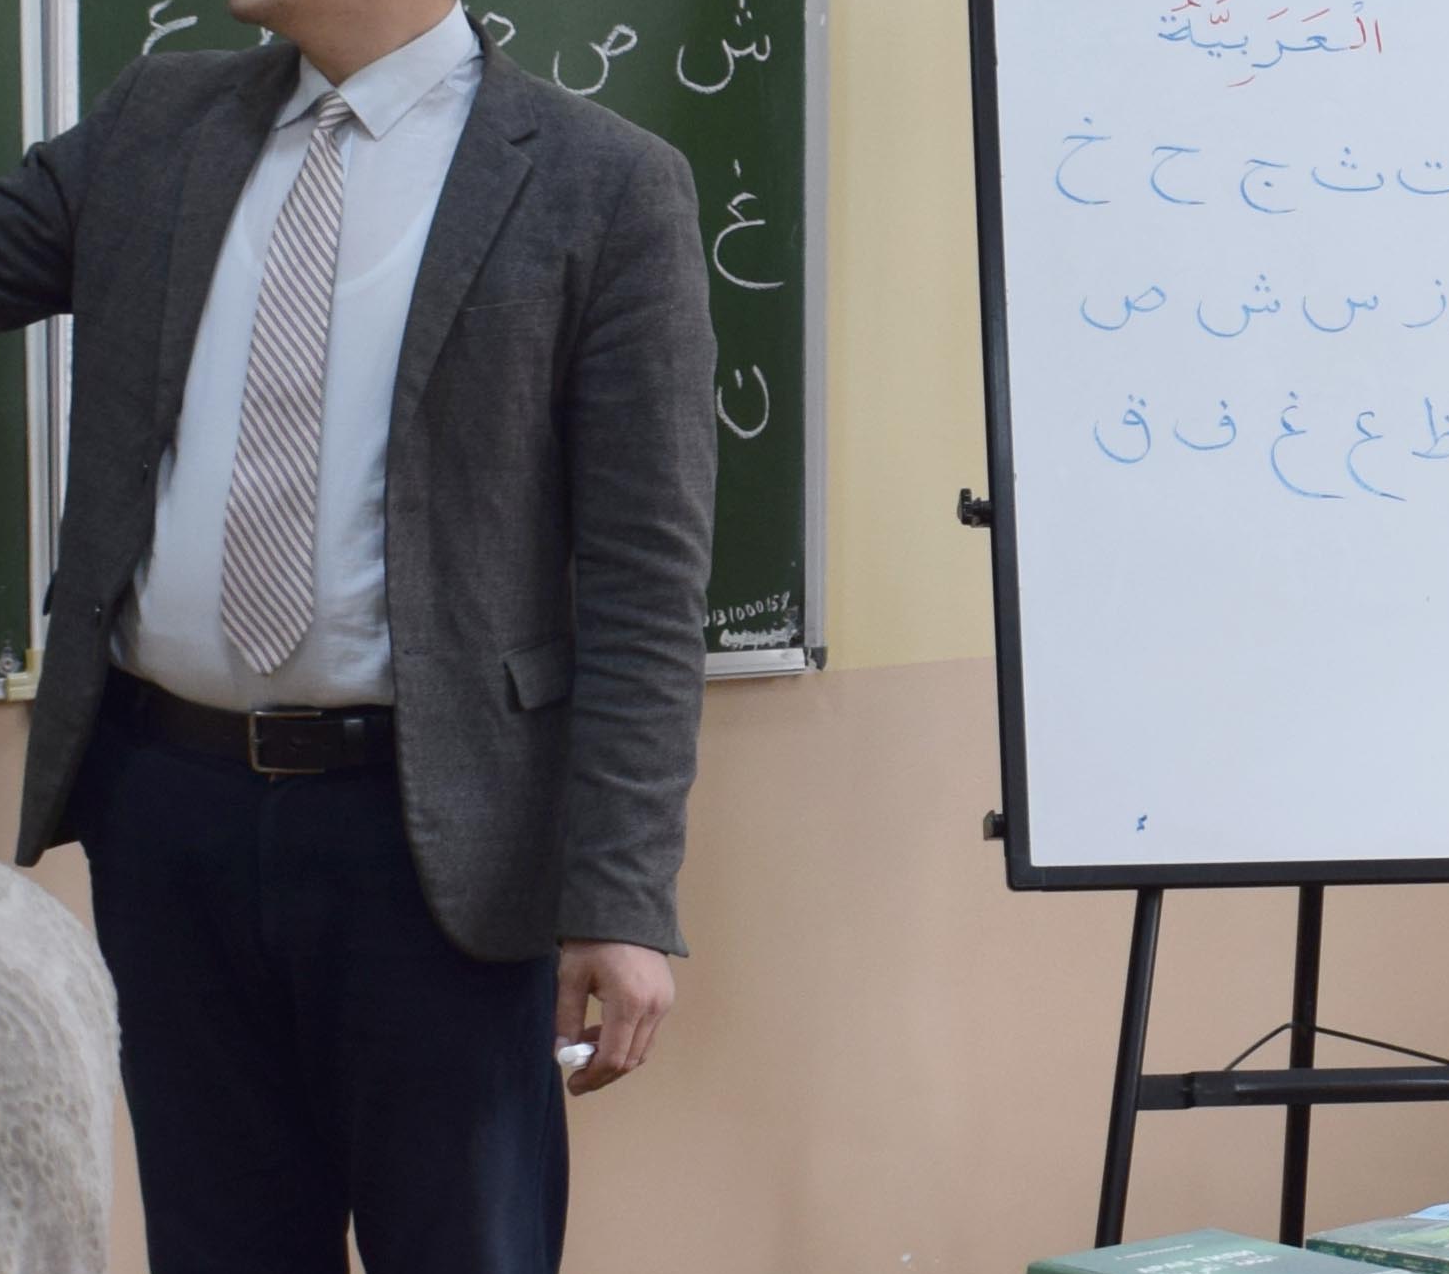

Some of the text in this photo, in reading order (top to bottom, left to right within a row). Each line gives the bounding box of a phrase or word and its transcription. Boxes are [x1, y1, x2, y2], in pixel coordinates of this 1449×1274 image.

[553, 24, 639, 96] ص
[1055, 116, 1113, 205] خ
[1150, 145, 1206, 205] ح
[1239, 158, 1297, 215] ج
[1311, 146, 1385, 192] ث
[713, 158, 786, 290] غ
[1079, 283, 1167, 331] ص
[1195, 273, 1282, 337] ش
[1301, 293, 1380, 333] س
[1401, 278, 1447, 329] ز
[717, 364, 770, 440] ن
[1094, 394, 1152, 465] ق
[1173, 399, 1238, 452] ف
[1269, 391, 1345, 500] غ
[1346, 410, 1408, 503] ع
